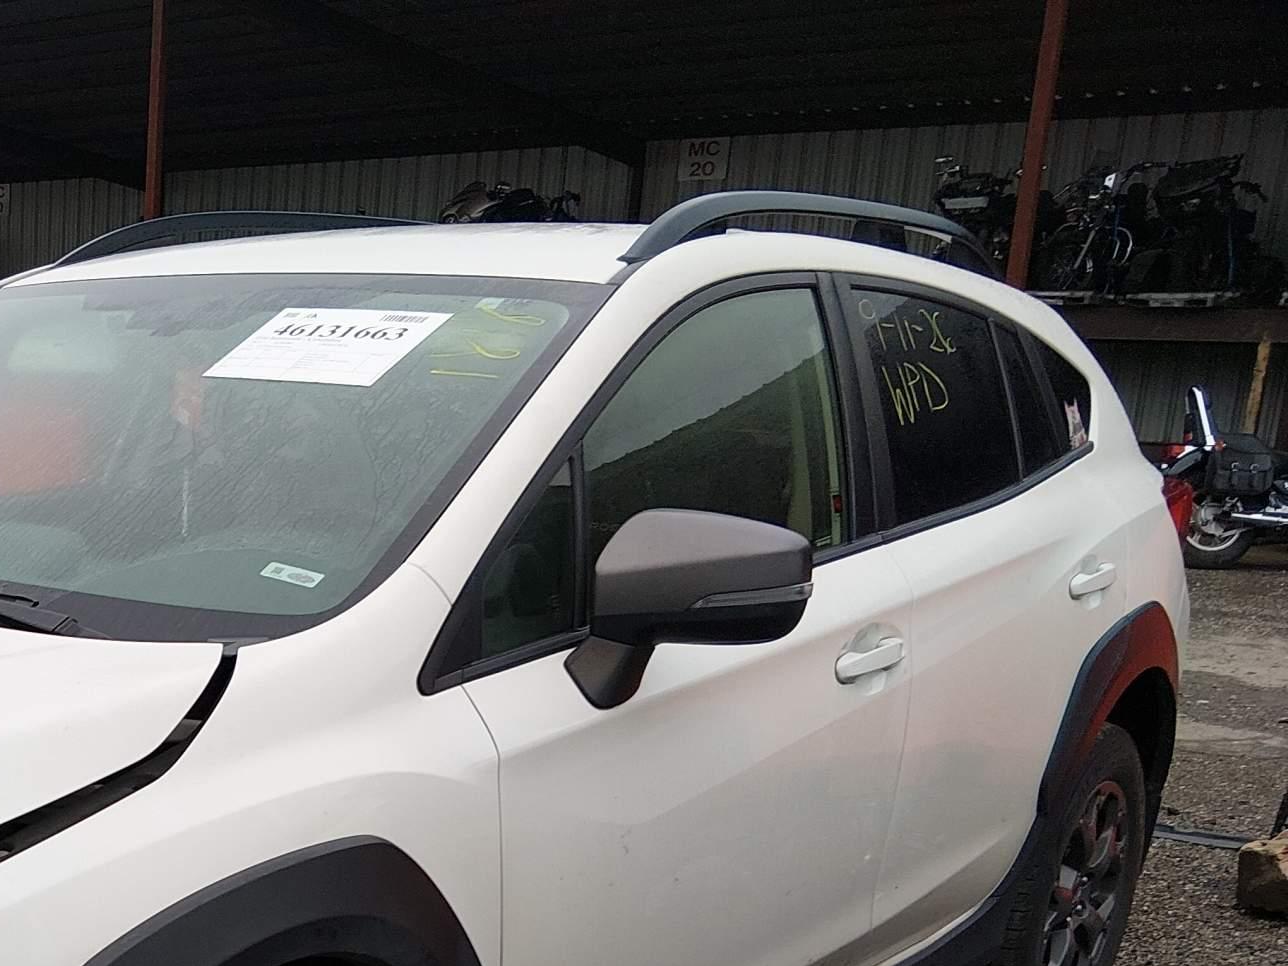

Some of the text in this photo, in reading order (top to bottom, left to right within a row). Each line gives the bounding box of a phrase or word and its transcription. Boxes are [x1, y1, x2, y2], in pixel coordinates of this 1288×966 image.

[688, 140, 721, 157] MC
[689, 161, 715, 177] 20
[273, 323, 409, 341] 46131663
